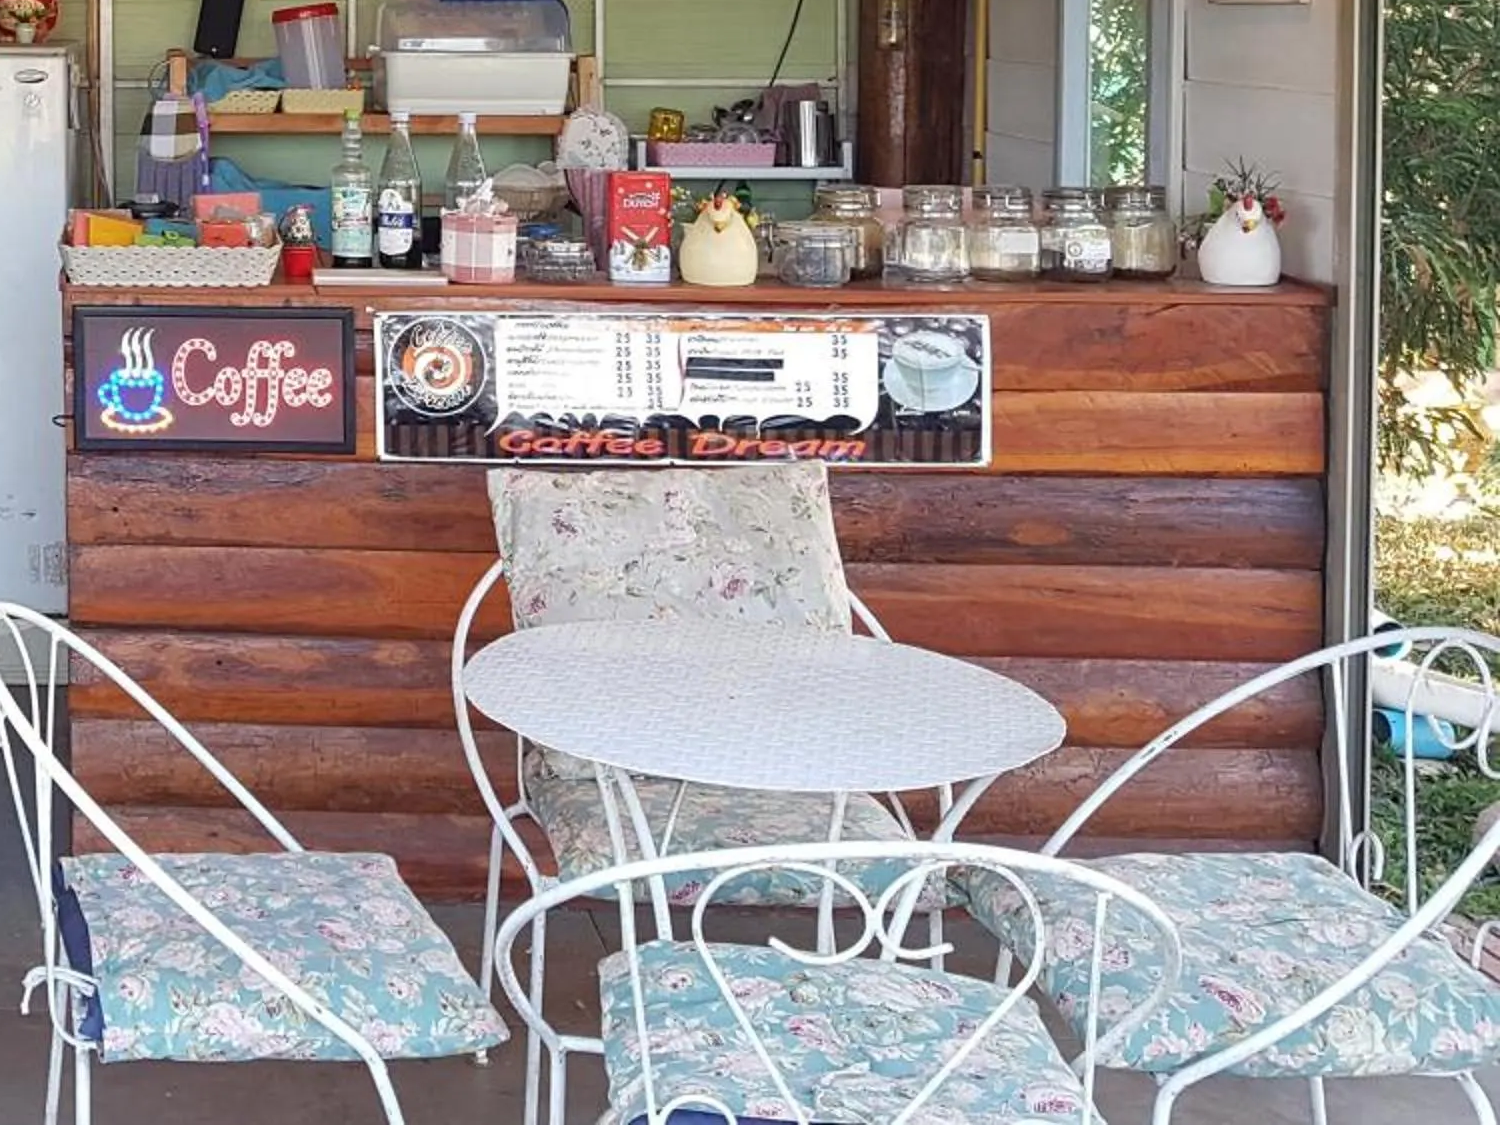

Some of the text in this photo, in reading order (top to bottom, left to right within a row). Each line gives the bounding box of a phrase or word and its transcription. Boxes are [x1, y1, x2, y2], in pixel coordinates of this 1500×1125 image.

[615, 333, 661, 344] 25 35
[831, 334, 848, 345] 35
[615, 347, 631, 358] 25
[645, 346, 661, 357] 35
[831, 348, 848, 359] 35
[615, 359, 661, 372] 25 35
[171, 338, 333, 427] Coffee
[616, 373, 632, 384] 25
[796, 396, 813, 408] 25
[833, 397, 849, 408] 35
[500, 428, 868, 459] Coffee Dream
